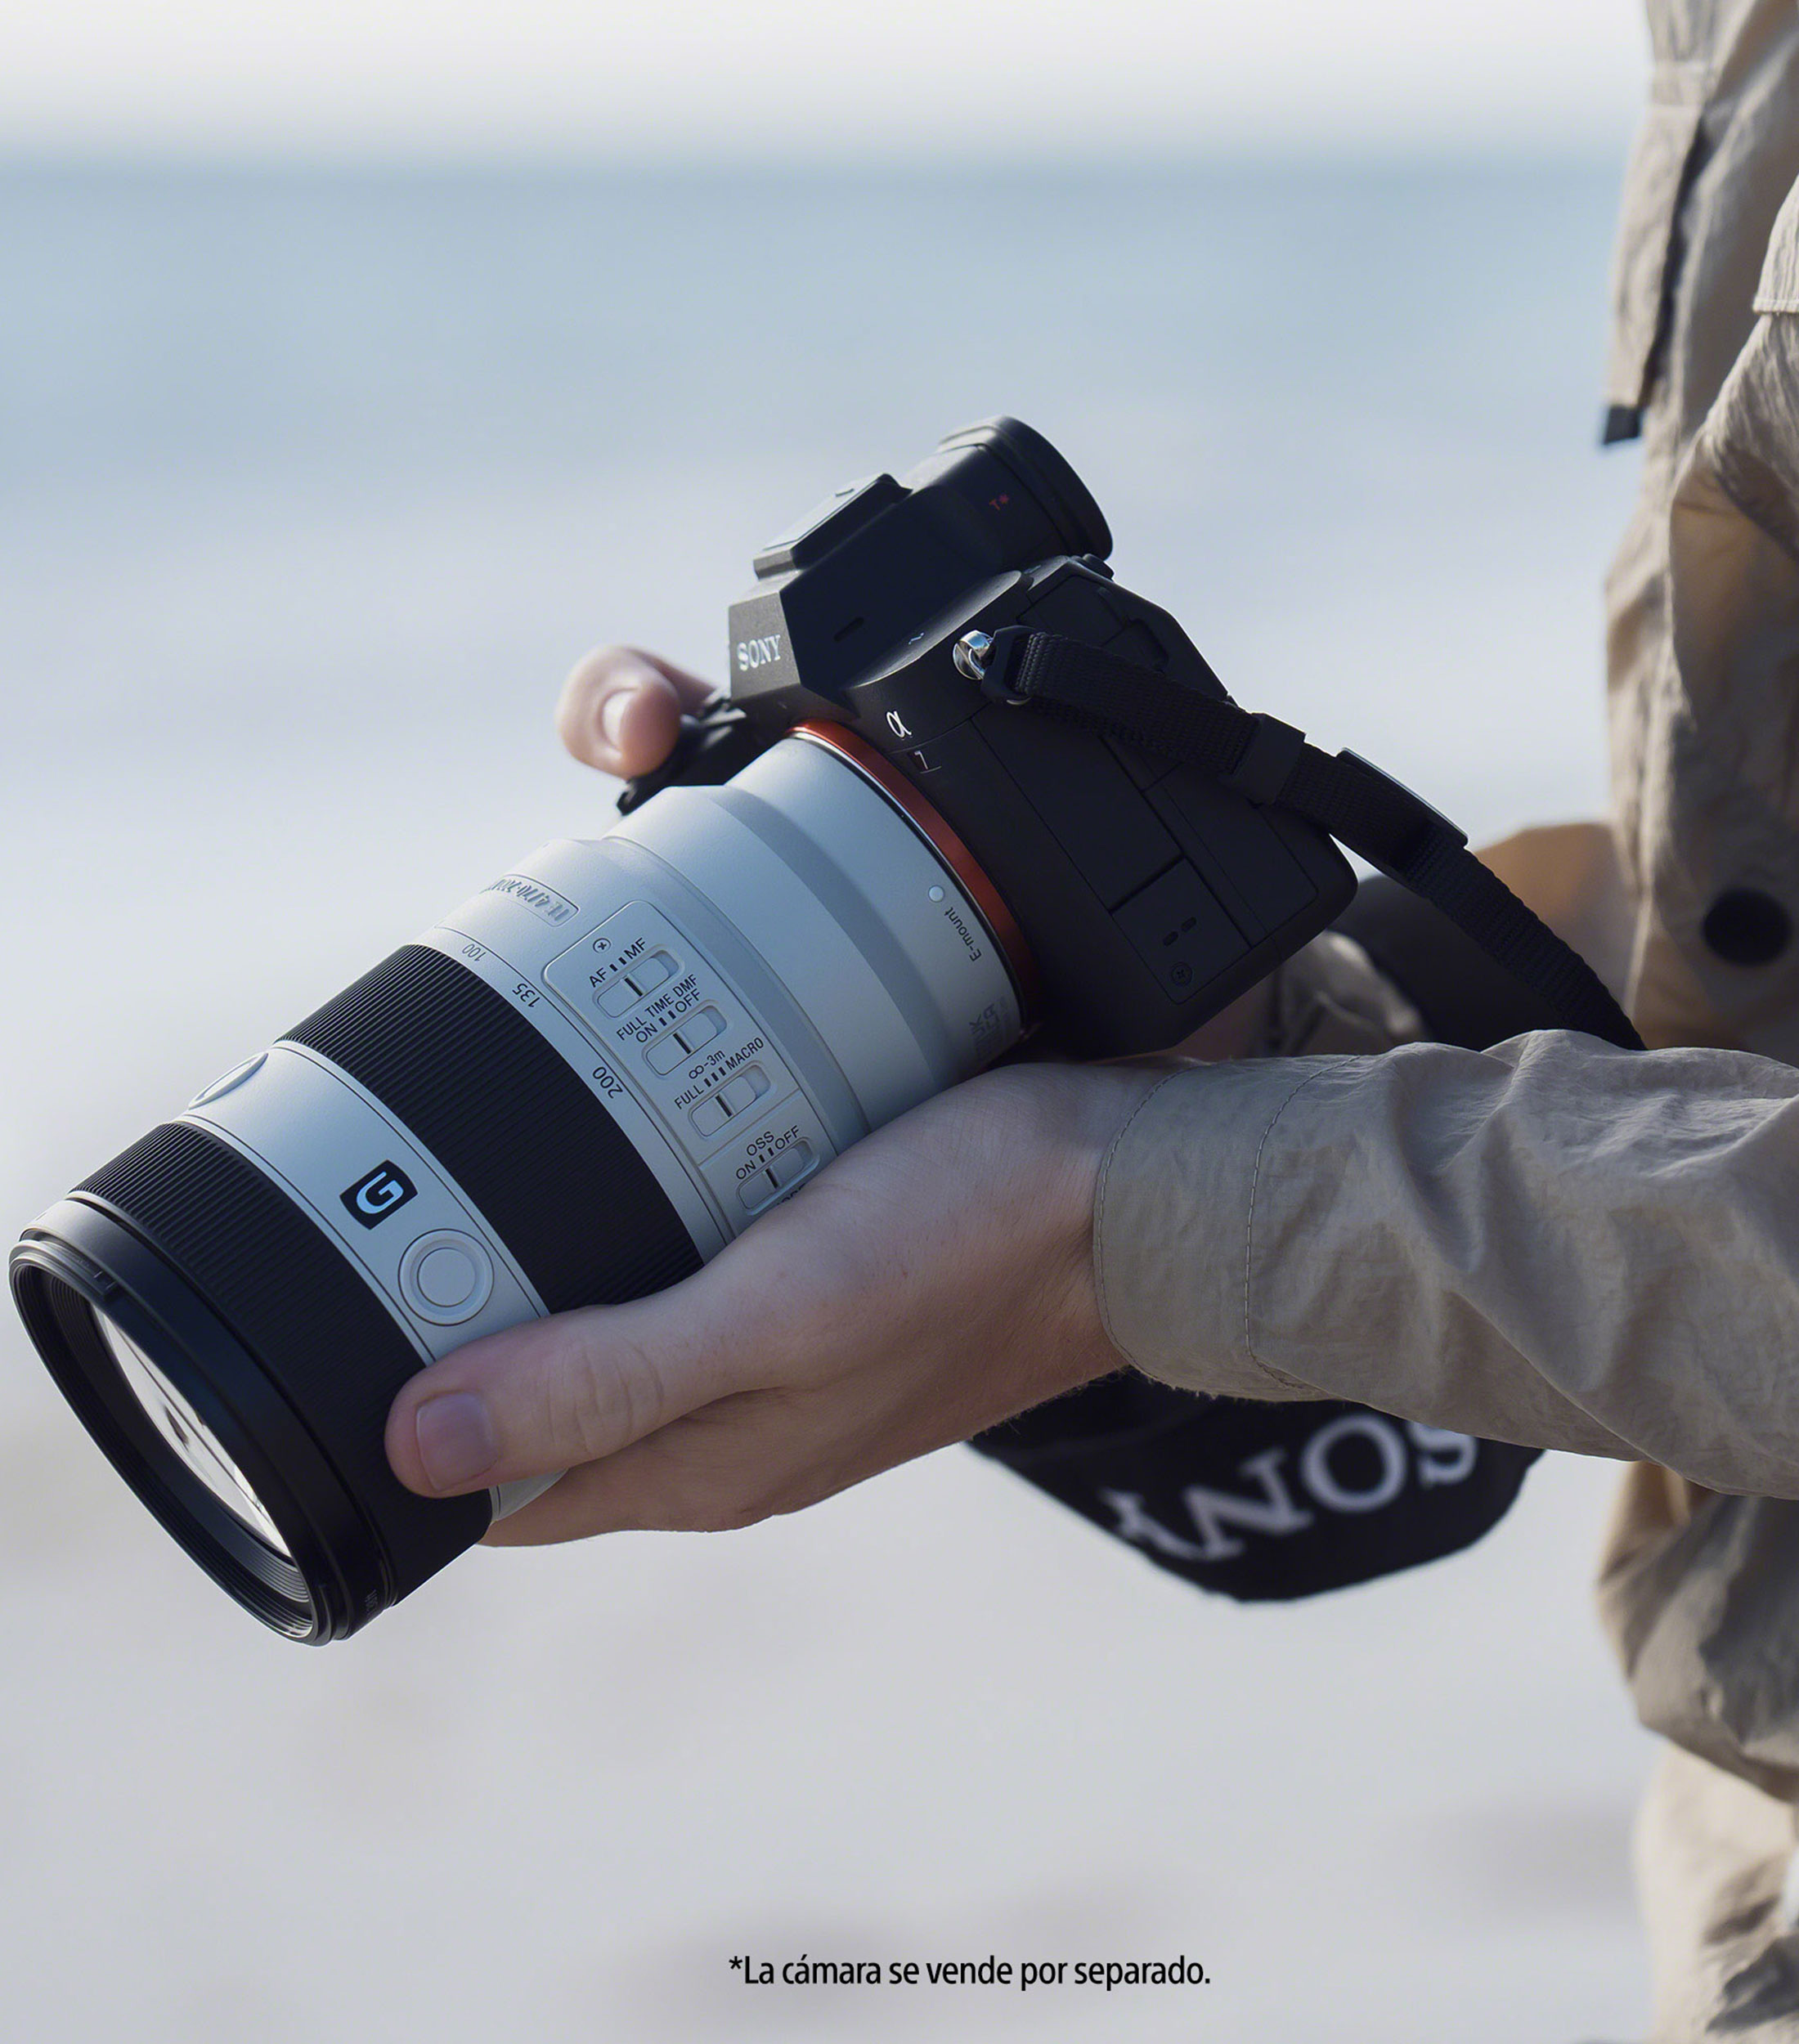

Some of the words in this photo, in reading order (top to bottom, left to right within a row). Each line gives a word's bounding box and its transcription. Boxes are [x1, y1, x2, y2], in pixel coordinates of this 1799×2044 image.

[737, 634, 781, 670] SONY
[462, 944, 487, 961] 100
[944, 907, 982, 961] E-mount
[589, 967, 607, 988] AF
[624, 937, 646, 960] MF
[512, 983, 541, 1007] 135
[616, 1016, 647, 1041] FULL
[644, 993, 675, 1017] TIME
[672, 974, 697, 997] DMF
[635, 1023, 657, 1043] ON
[675, 988, 700, 1013] OFF
[592, 1066, 623, 1099] 200
[674, 1085, 704, 1109] FULL
[725, 1037, 764, 1071] MACRO
[736, 1160, 756, 1180] ON
[774, 1125, 801, 1150] OFF
[747, 1131, 774, 1156] OSS
[357, 1171, 404, 1214] G
[1098, 1412, 1478, 1562] SONY
